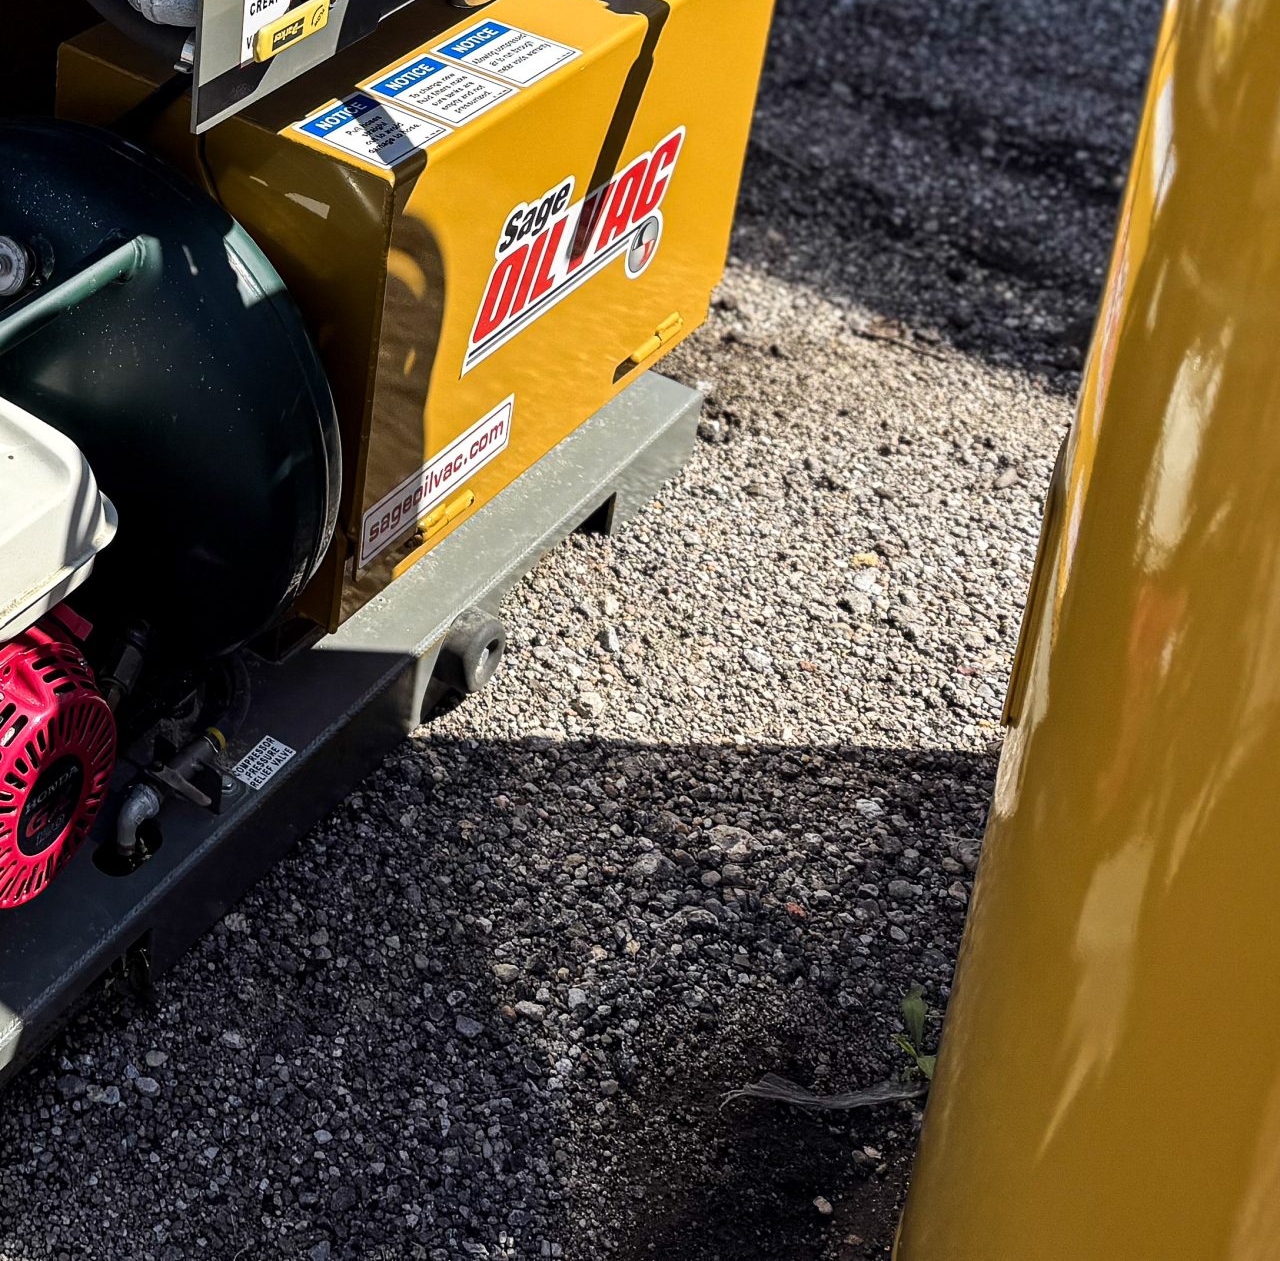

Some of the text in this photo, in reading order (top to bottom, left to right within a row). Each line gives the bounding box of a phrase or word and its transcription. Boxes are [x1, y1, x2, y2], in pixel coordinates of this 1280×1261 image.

[274, 22, 304, 43] Parker
[450, 27, 500, 53] NOTICE
[384, 62, 436, 90] NOTICE
[313, 100, 369, 130] NOTICE
[499, 182, 571, 253] Sage
[473, 132, 682, 344] OIL VAC
[369, 420, 504, 542] sageoilvac.com
[232, 737, 275, 777] COMPRESSOR
[245, 746, 280, 778] PRESSURE
[250, 747, 293, 788] RELIEF VALVE
[25, 766, 79, 815] HONDA
